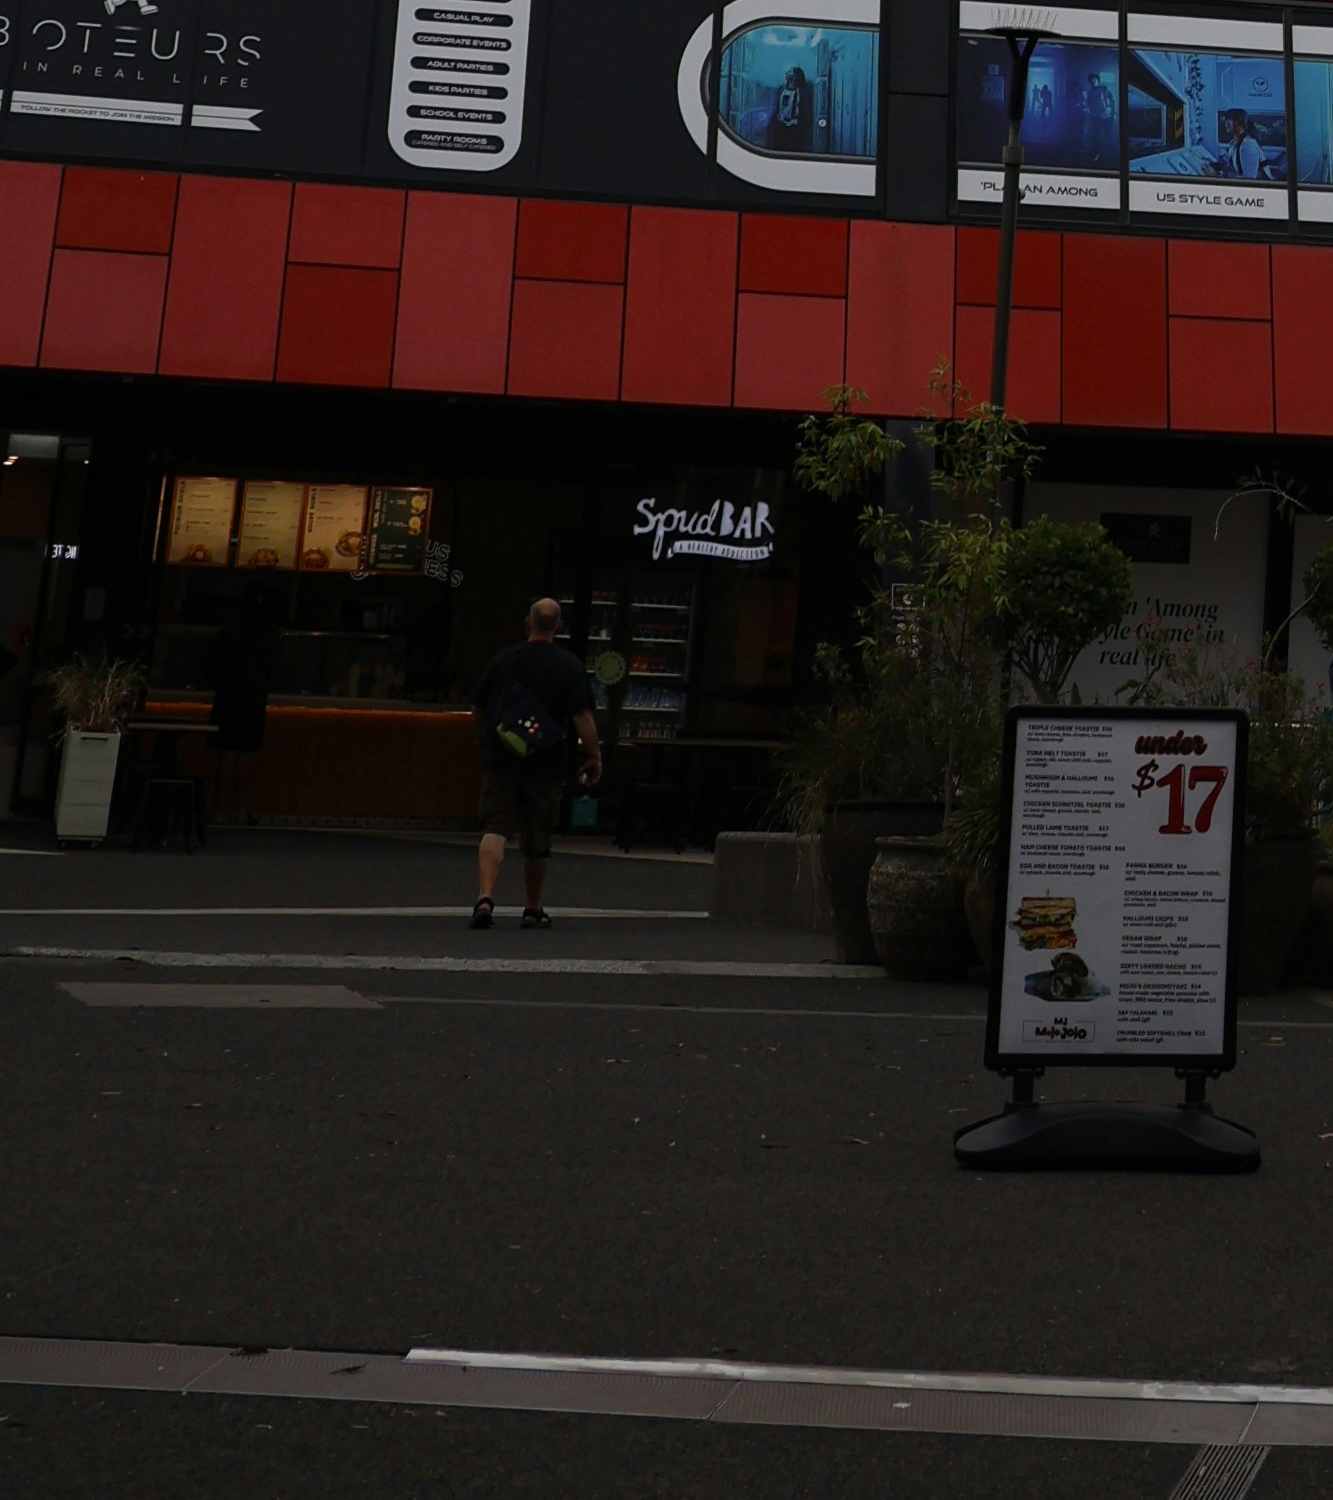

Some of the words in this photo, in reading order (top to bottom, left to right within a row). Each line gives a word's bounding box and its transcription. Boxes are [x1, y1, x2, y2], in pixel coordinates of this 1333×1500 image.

[433, 12, 470, 22] CASUAL
[470, 15, 496, 23] PLAY
[416, 35, 472, 47] CORPORATE
[472, 40, 508, 49] EVENTS
[426, 60, 456, 69] ADULT
[456, 62, 494, 72] PARTIES
[23, 61, 48, 72] IN
[72, 64, 145, 81] REAL
[172, 74, 250, 88] LIFE
[428, 85, 450, 93] KIDS
[450, 86, 488, 95] PARTIES
[20, 104, 52, 113] FOLLOW
[68, 107, 99, 117] ROCKET
[110, 111, 127, 119] JOIN
[420, 109, 457, 118] SCHOOL
[457, 111, 493, 120] EVENTS
[421, 133, 452, 142] PARTY
[453, 135, 488, 145] ROOMS
[1024, 184, 1043, 195] AN
[1046, 185, 1098, 198] AMONG
[1155, 192, 1176, 203] US
[1179, 194, 1222, 206] STYLE
[1224, 197, 1265, 208] GAME
[1145, 597, 1219, 623] 'Among
[1099, 647, 1139, 666] real
[1134, 729, 1208, 756] under
[1131, 759, 1229, 835] $17
